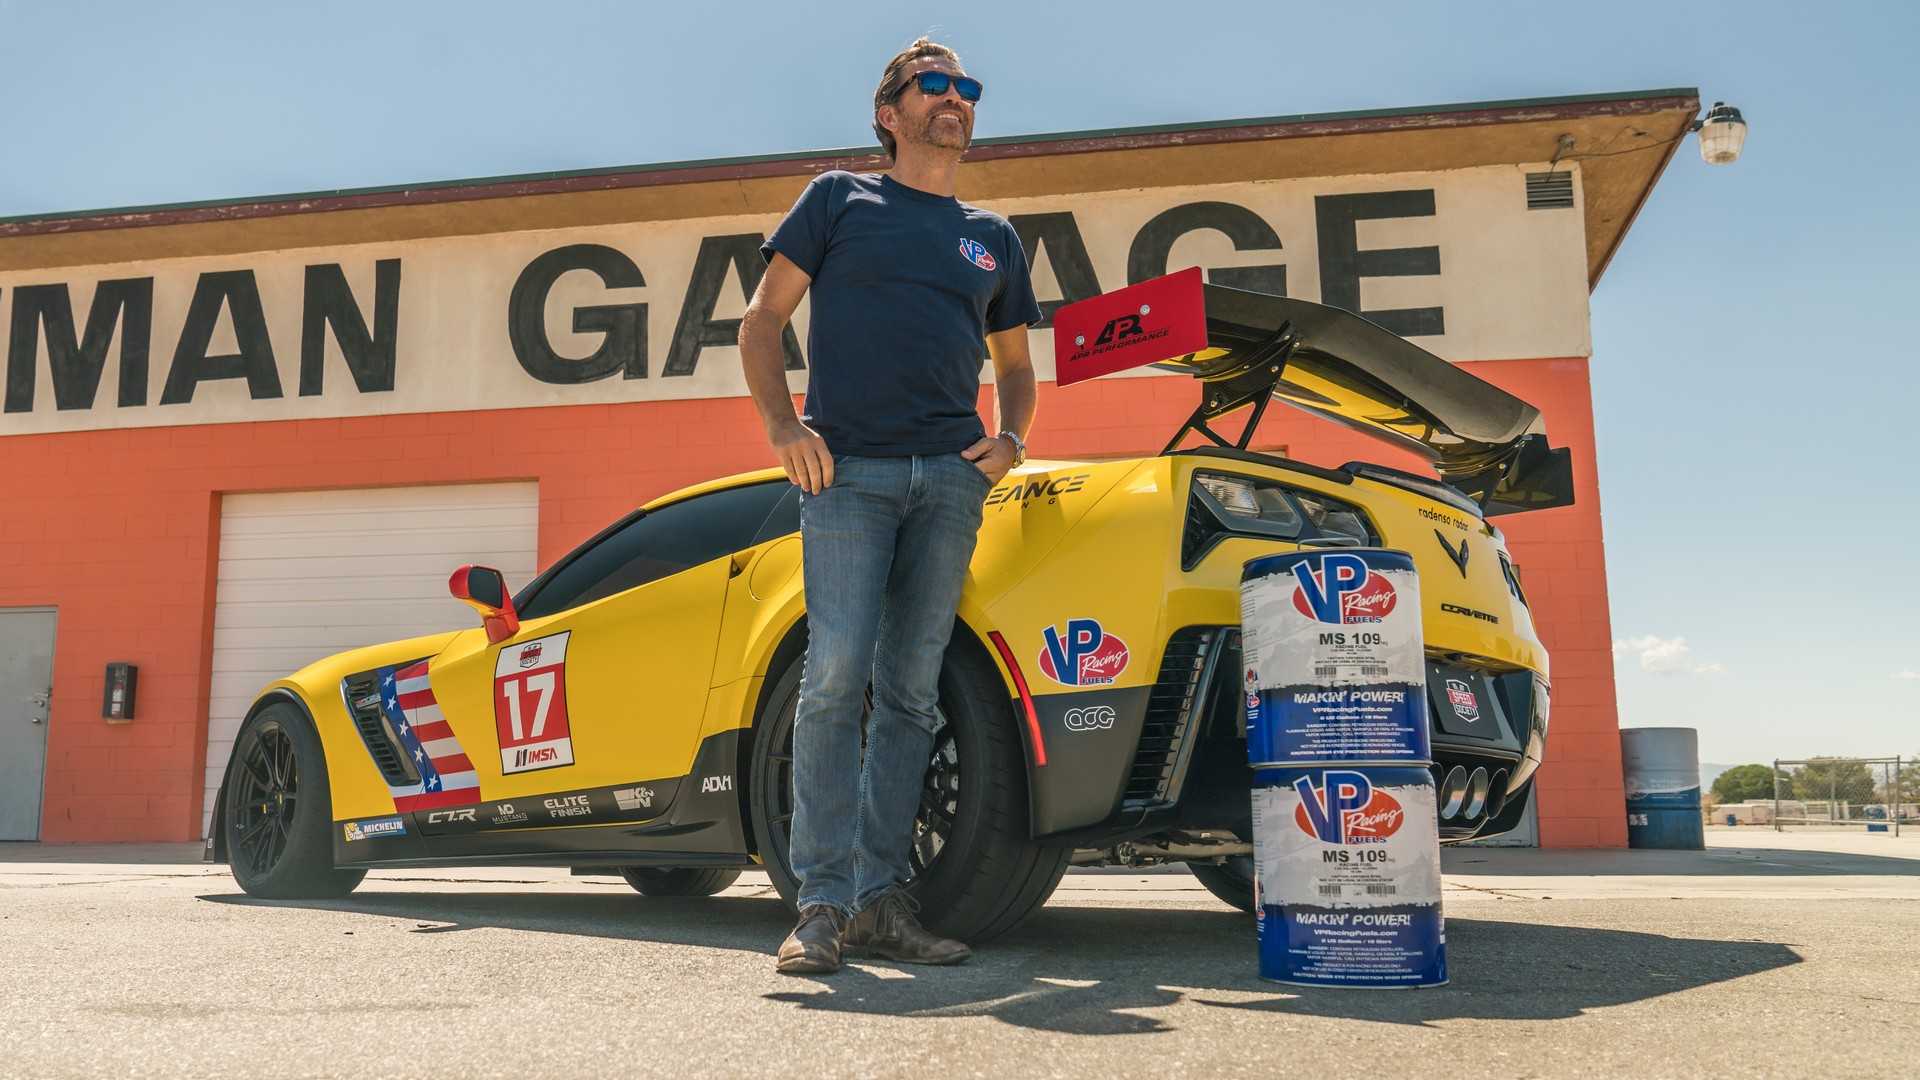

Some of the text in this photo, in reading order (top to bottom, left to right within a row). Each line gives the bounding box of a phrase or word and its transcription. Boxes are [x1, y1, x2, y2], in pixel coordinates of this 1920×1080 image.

[960, 238, 986, 264] VP
[0, 189, 1445, 413] MAN GAAGE
[1418, 507, 1451, 526] radenso
[1291, 554, 1369, 624] VP
[1345, 590, 1395, 615] Racing
[1344, 616, 1382, 624] FUELS
[1441, 603, 1499, 624] CORVETTE
[1319, 633, 1346, 645] MS
[1352, 633, 1380, 645] 109
[1041, 617, 1104, 686] VP
[1082, 651, 1128, 677] Racing
[503, 671, 555, 741] 17
[1294, 690, 1406, 704] MAKIN' POWER!
[528, 747, 558, 763] IMSA
[544, 795, 590, 809] ELITE
[1293, 770, 1372, 845] VP
[551, 806, 592, 818] FINISH
[1347, 808, 1402, 834] Racing
[363, 820, 403, 833] MICHELIN
[1347, 836, 1387, 844] FUELS
[1322, 850, 1386, 863] MS 109
[1296, 913, 1411, 926] MAKIN' POWER!
